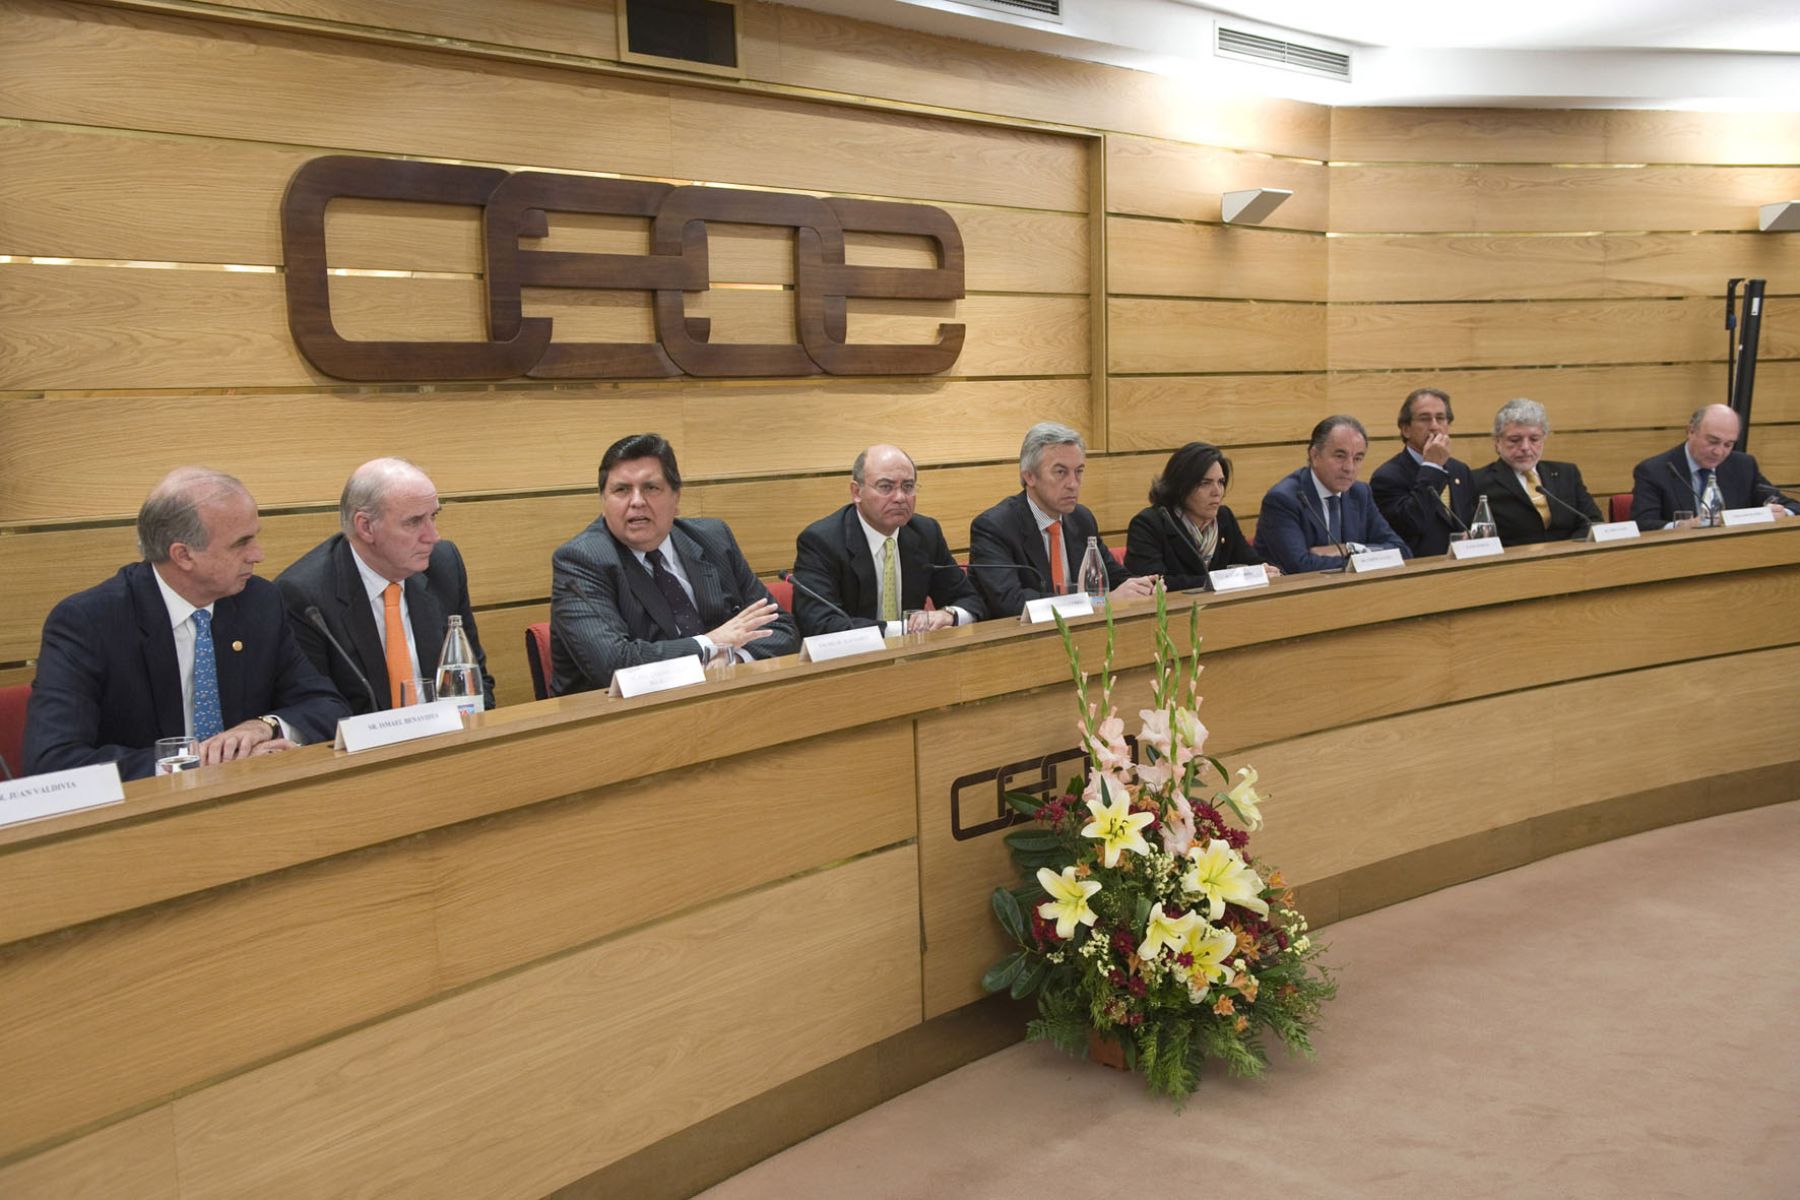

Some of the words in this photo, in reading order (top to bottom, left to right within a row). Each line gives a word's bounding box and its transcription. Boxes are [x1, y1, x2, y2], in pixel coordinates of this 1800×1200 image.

[378, 718, 404, 729] ISMAEL
[9, 789, 33, 801] JUAN
[33, 781, 77, 795] VALDIVIA
